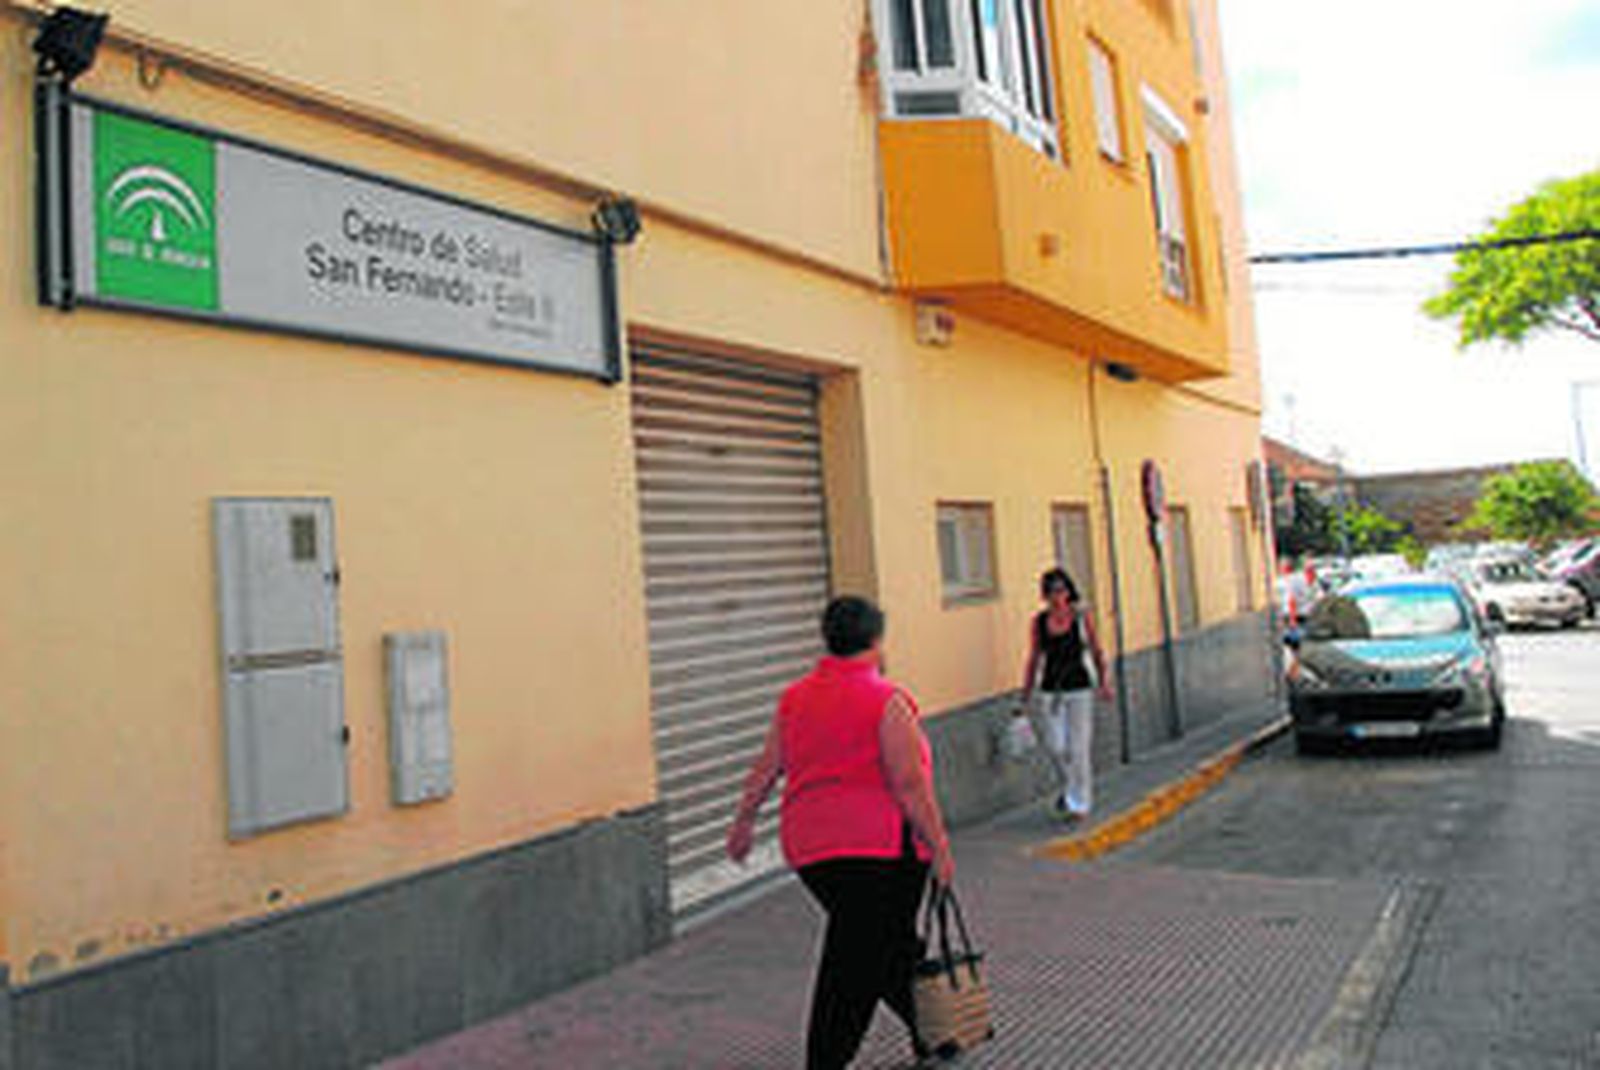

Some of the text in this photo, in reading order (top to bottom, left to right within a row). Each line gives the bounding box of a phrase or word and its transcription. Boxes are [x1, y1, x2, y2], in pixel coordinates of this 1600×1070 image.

[342, 208, 426, 255] Centro
[431, 231, 458, 263] de
[305, 243, 360, 286] San
[366, 255, 476, 307] Fernando
